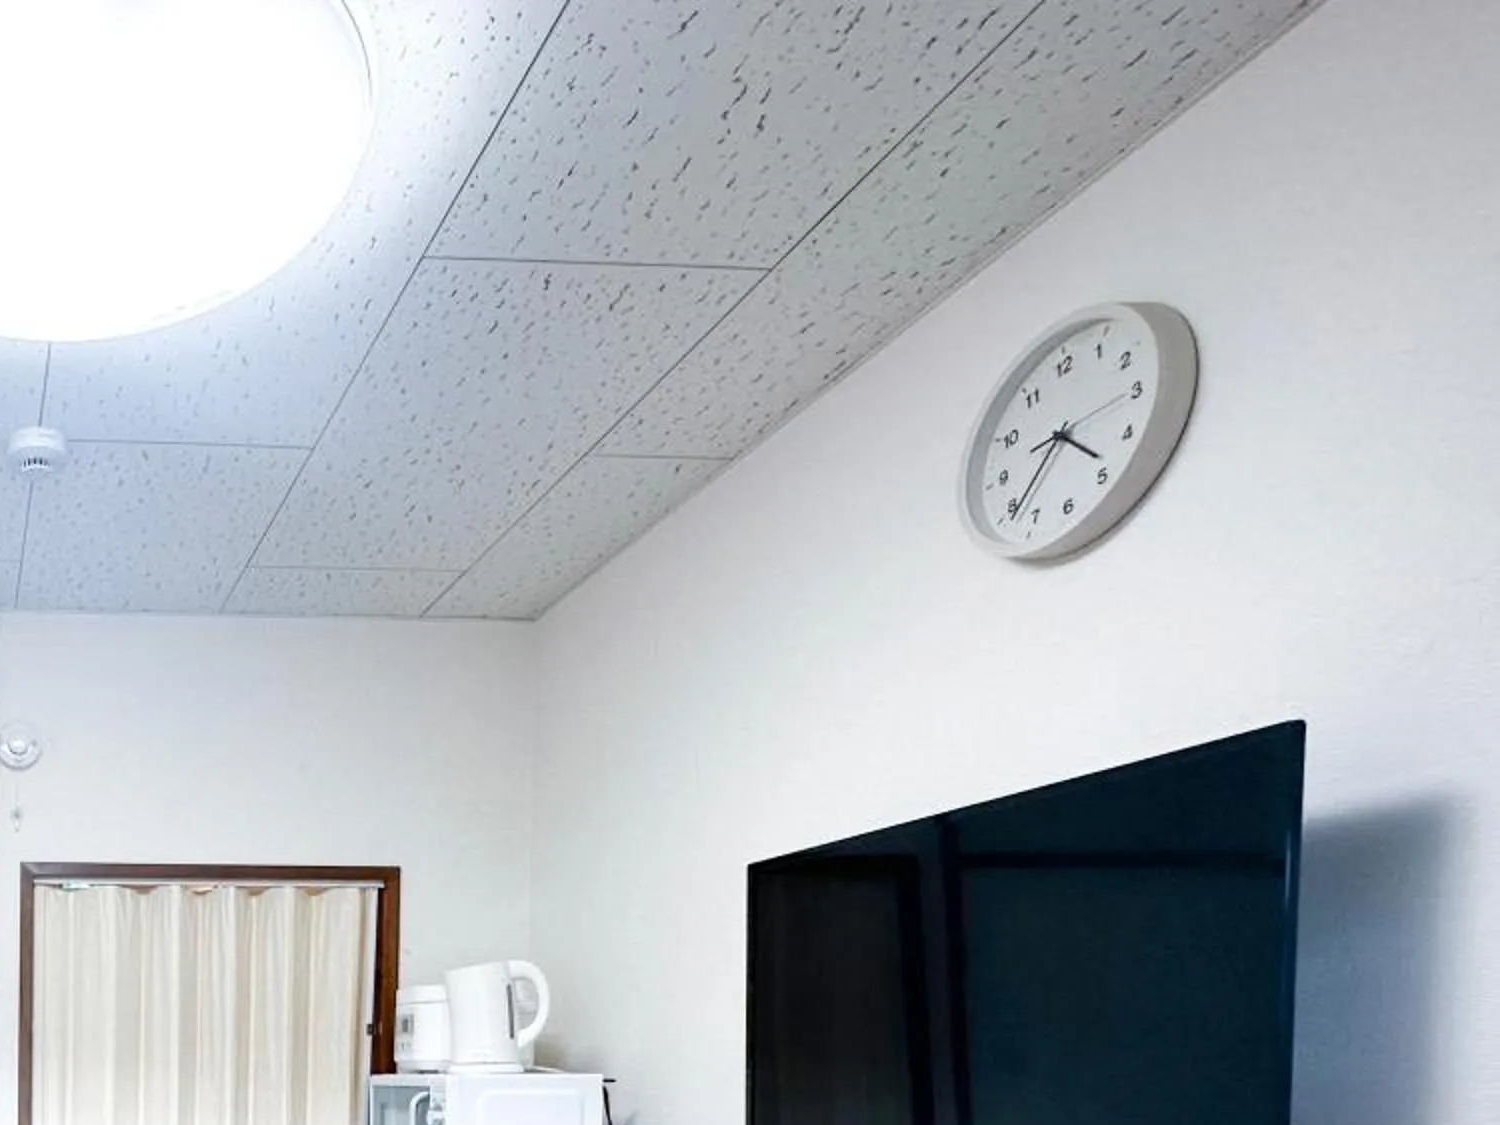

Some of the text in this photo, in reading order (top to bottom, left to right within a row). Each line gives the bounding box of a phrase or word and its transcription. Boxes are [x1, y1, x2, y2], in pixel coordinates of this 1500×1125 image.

[1096, 344, 1102, 359] 1
[1056, 355, 1073, 378] 12
[1120, 351, 1132, 370] 2
[1025, 389, 1040, 408] 11
[1131, 381, 1143, 399] 3
[1003, 430, 1019, 448] 10
[1121, 425, 1133, 441] 4
[999, 470, 1009, 485] 9
[1097, 468, 1108, 485] 5
[1063, 498, 1074, 515] 6
[1032, 508, 1041, 524] 7
